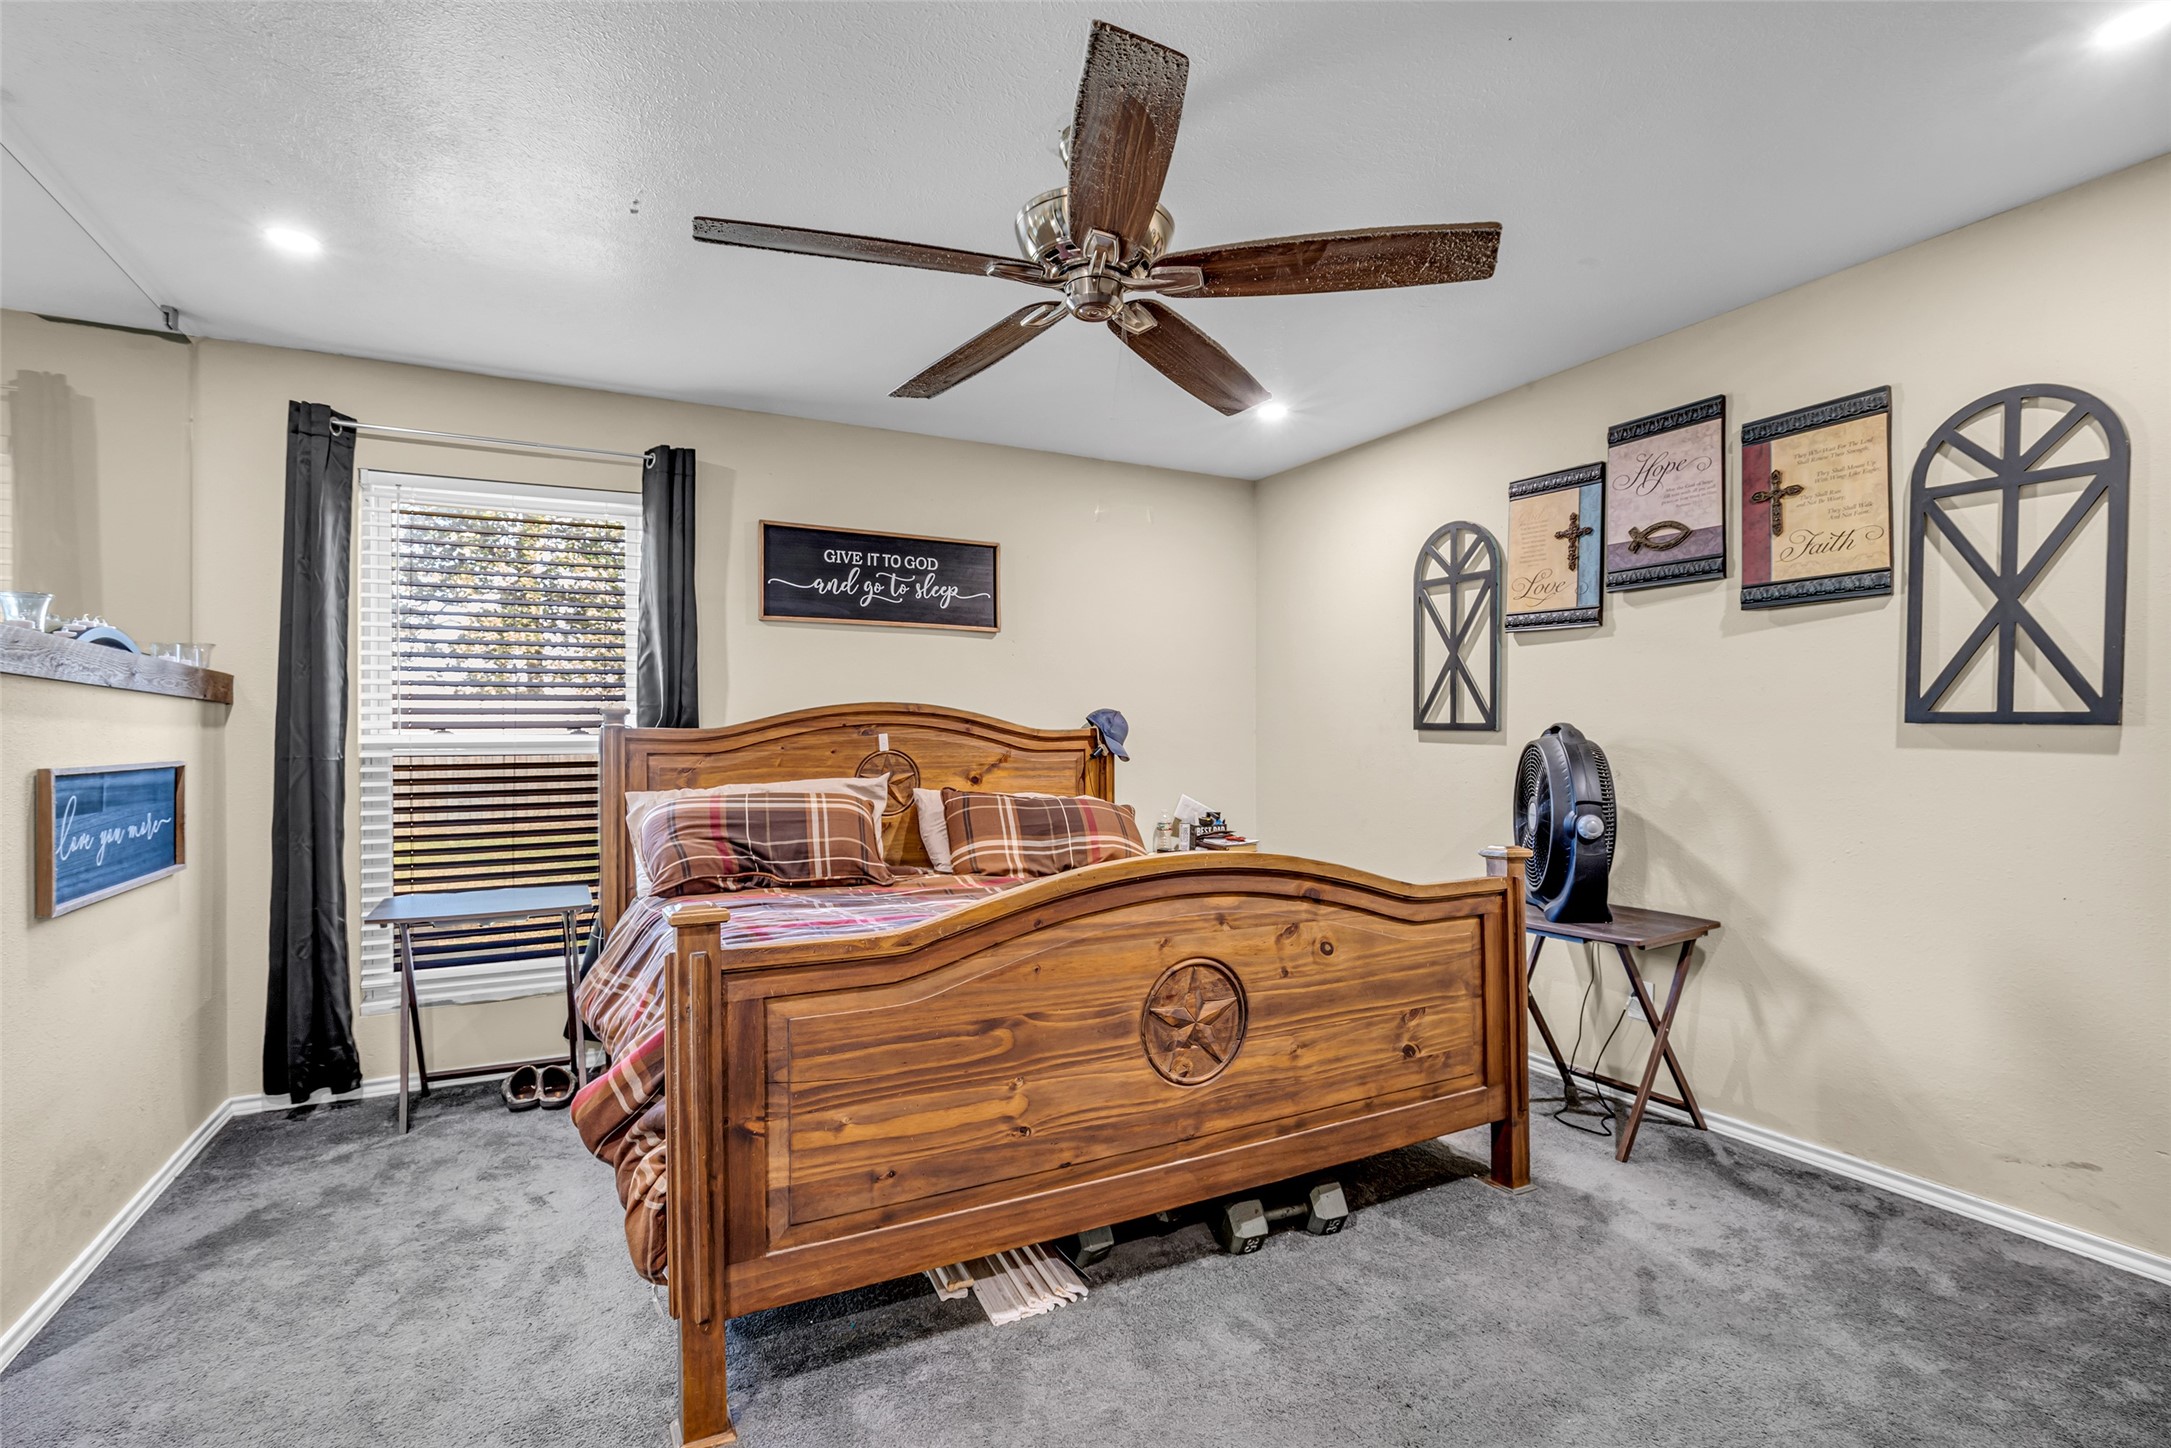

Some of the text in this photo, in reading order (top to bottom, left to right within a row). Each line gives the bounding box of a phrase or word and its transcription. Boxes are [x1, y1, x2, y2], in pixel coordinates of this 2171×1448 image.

[1612, 452, 1712, 496] Hope
[824, 550, 938, 570] GIVE IT TO GOD
[1777, 524, 1884, 562] Faith
[768, 567, 861, 594] and
[876, 573, 916, 597] to
[916, 573, 990, 609] sleep
[1512, 568, 1588, 607] Love
[96, 827, 124, 866] you
[128, 812, 171, 840] more
[1244, 1238, 1260, 1253] 35
[1326, 1219, 1341, 1234] 35
